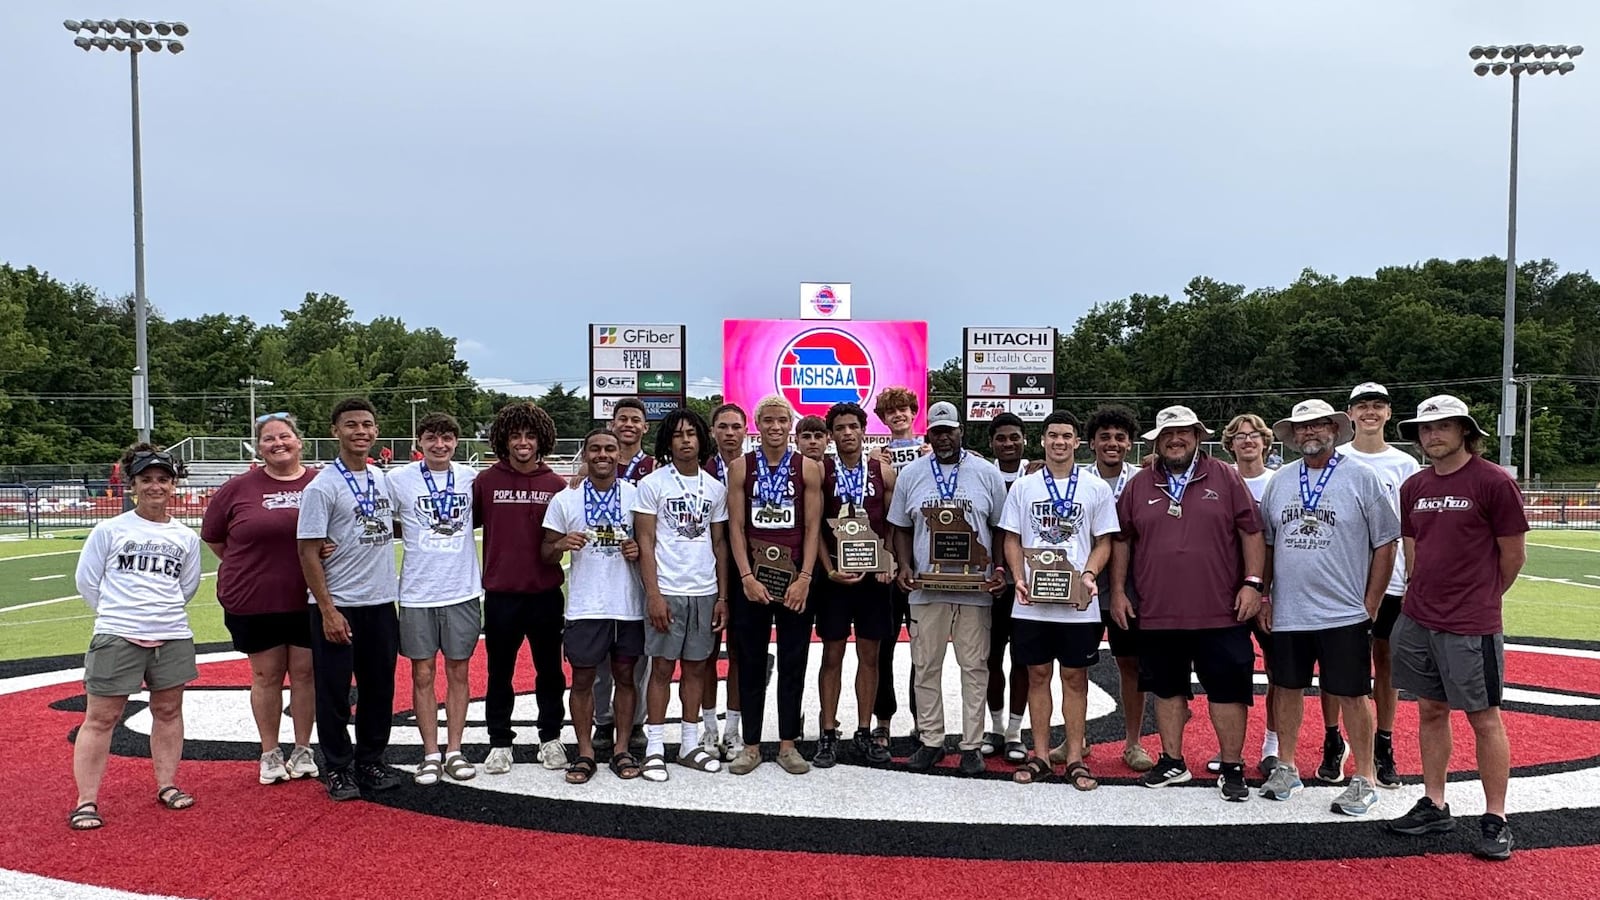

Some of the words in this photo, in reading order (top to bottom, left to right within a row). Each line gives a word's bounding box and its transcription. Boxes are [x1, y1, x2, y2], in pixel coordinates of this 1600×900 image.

[623, 329, 675, 343] GFiber
[974, 333, 1047, 345] HITACHI
[987, 353, 1020, 363] Health
[1023, 353, 1047, 363] Care
[624, 360, 650, 369] TECH
[793, 367, 856, 386] MSHSAA
[972, 401, 1006, 409] PEAK
[493, 490, 528, 500] POPLAR
[670, 501, 710, 513] TRK
[1443, 496, 1469, 508] FIELD
[1035, 504, 1078, 516] TRK
[1281, 508, 1336, 526] CHAIONS
[117, 554, 183, 578] MULES
